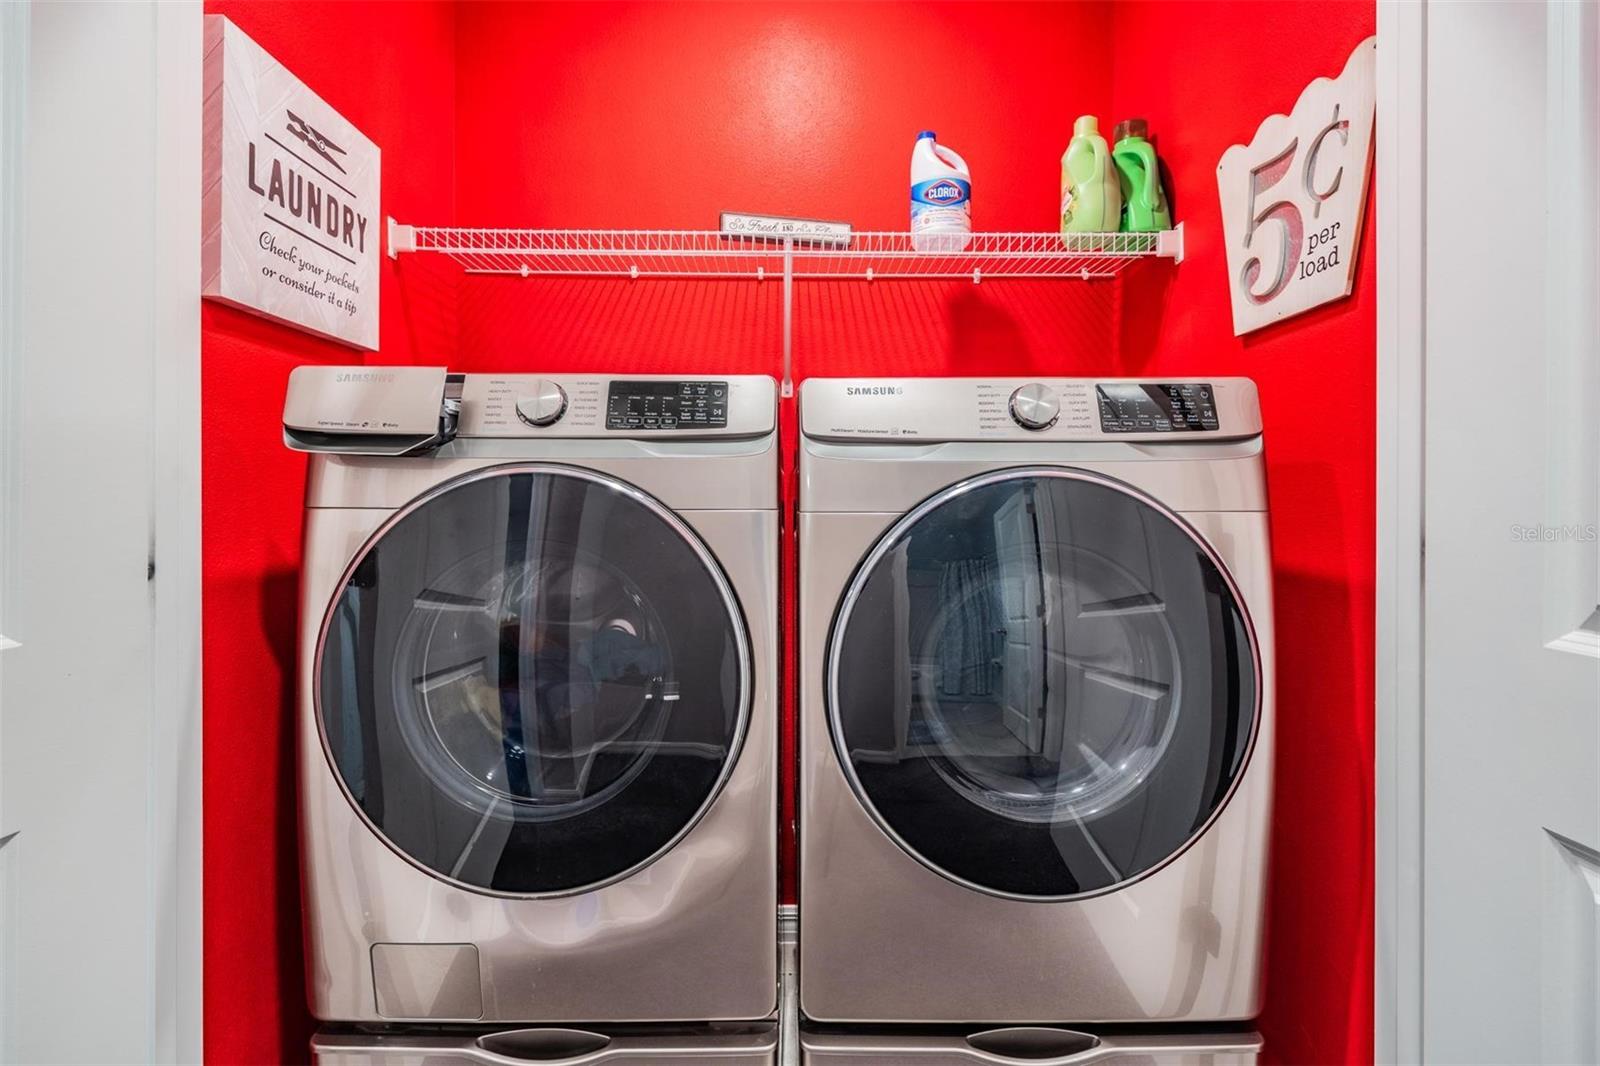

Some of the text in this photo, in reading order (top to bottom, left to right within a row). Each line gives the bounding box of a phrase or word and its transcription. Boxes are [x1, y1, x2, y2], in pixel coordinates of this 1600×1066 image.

[248, 141, 368, 254] LAUNDRY
[928, 186, 960, 199] CLOROX
[728, 217, 746, 231] So
[746, 217, 781, 233] Fresh
[1306, 222, 1341, 256] per
[259, 231, 360, 294] Check your pockets
[1299, 245, 1340, 280] load
[262, 266, 358, 317] or consider it a tip
[846, 386, 904, 396] SAMSUNG
